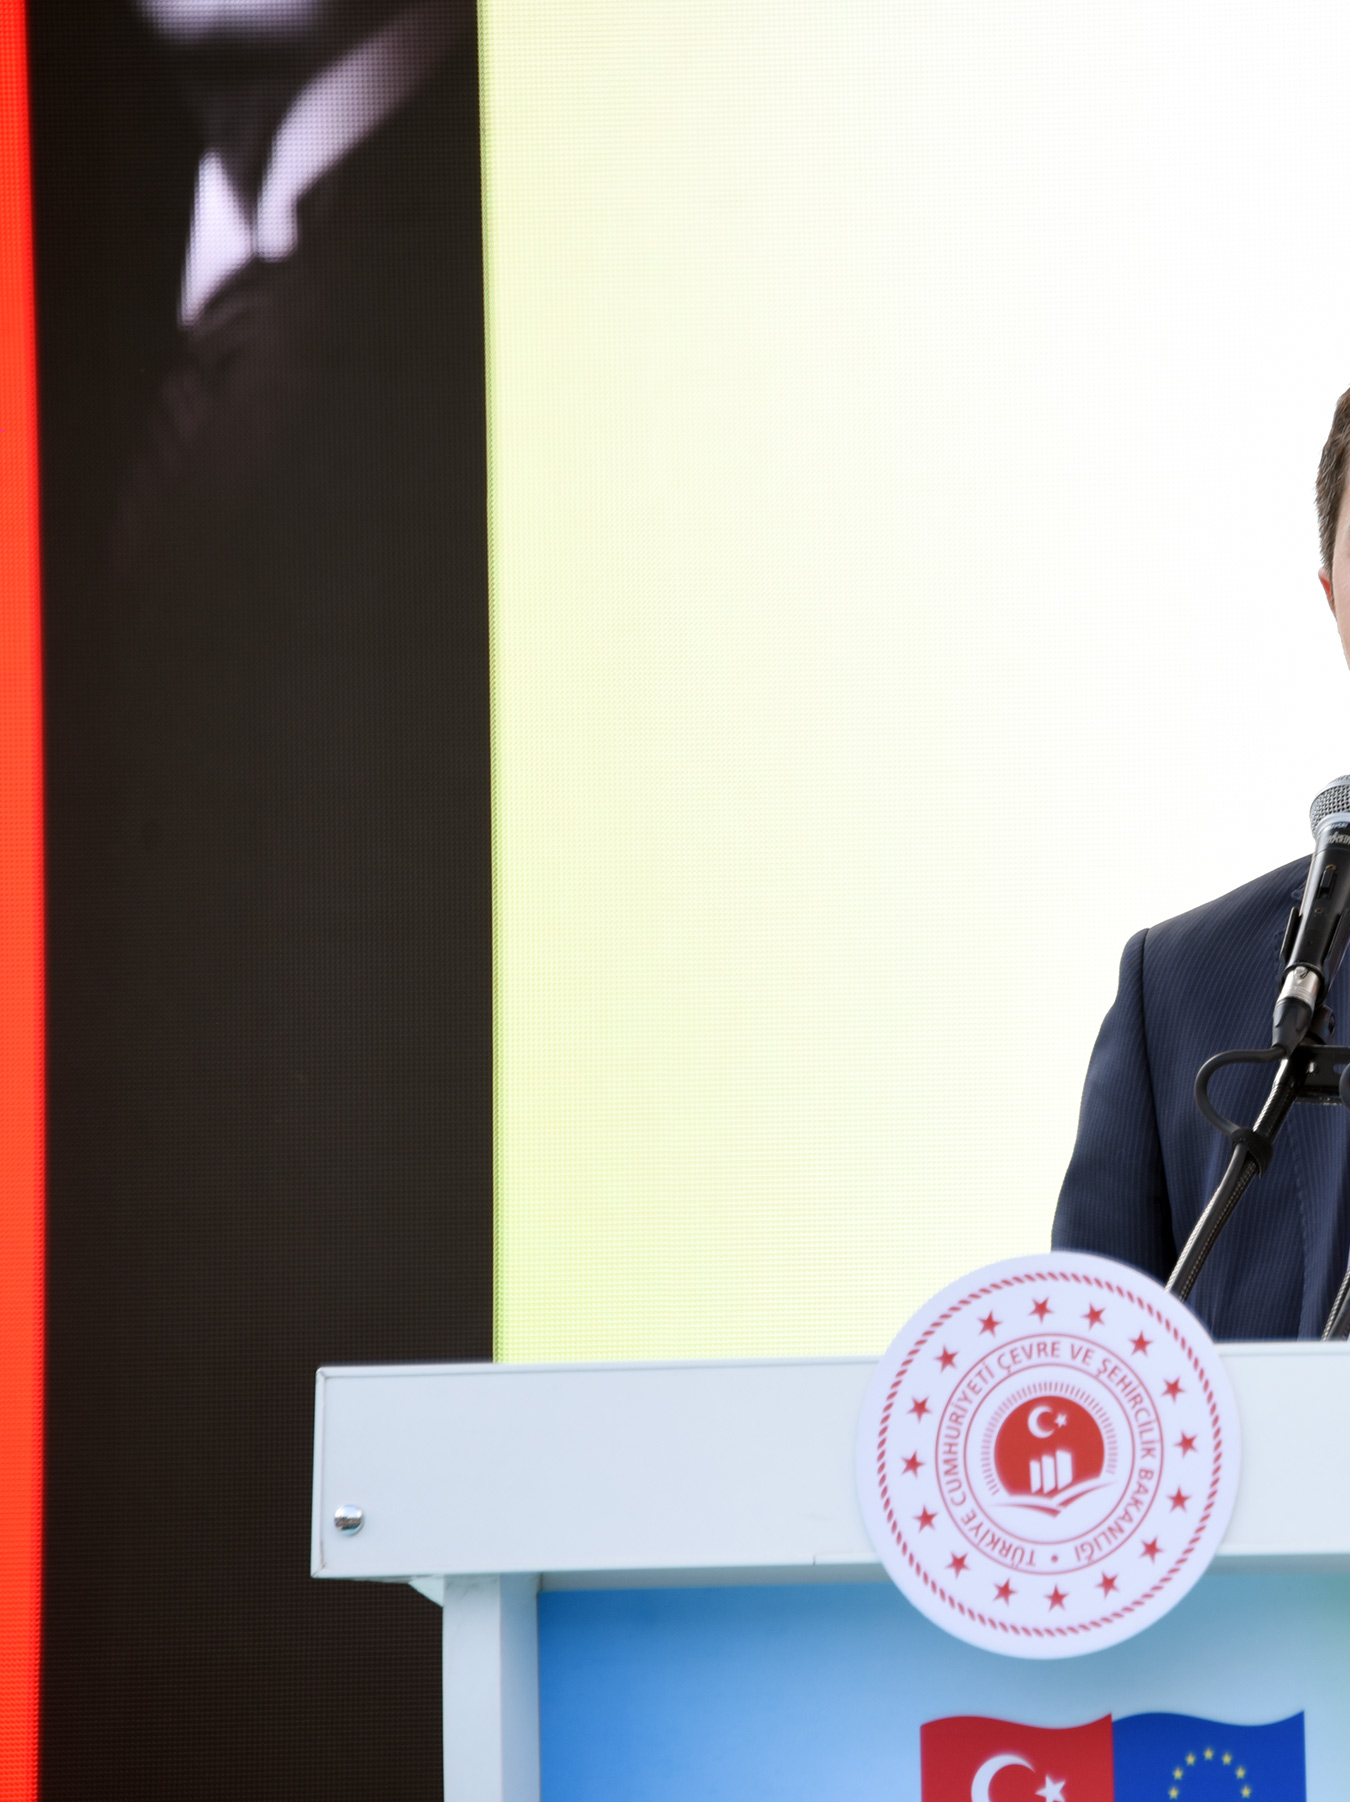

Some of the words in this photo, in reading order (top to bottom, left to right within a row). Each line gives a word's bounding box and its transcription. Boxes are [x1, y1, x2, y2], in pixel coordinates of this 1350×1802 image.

[998, 1341, 1060, 1376] ÇEVRE
[1070, 1343, 1095, 1367] VE
[943, 1360, 995, 1506] CUMHURİYETİ
[1096, 1358, 1157, 1459] ŞEHİRCİLİK
[960, 1509, 1036, 1568] TÜRKİYE
[1074, 1468, 1154, 1564] BAKANLIĞI
